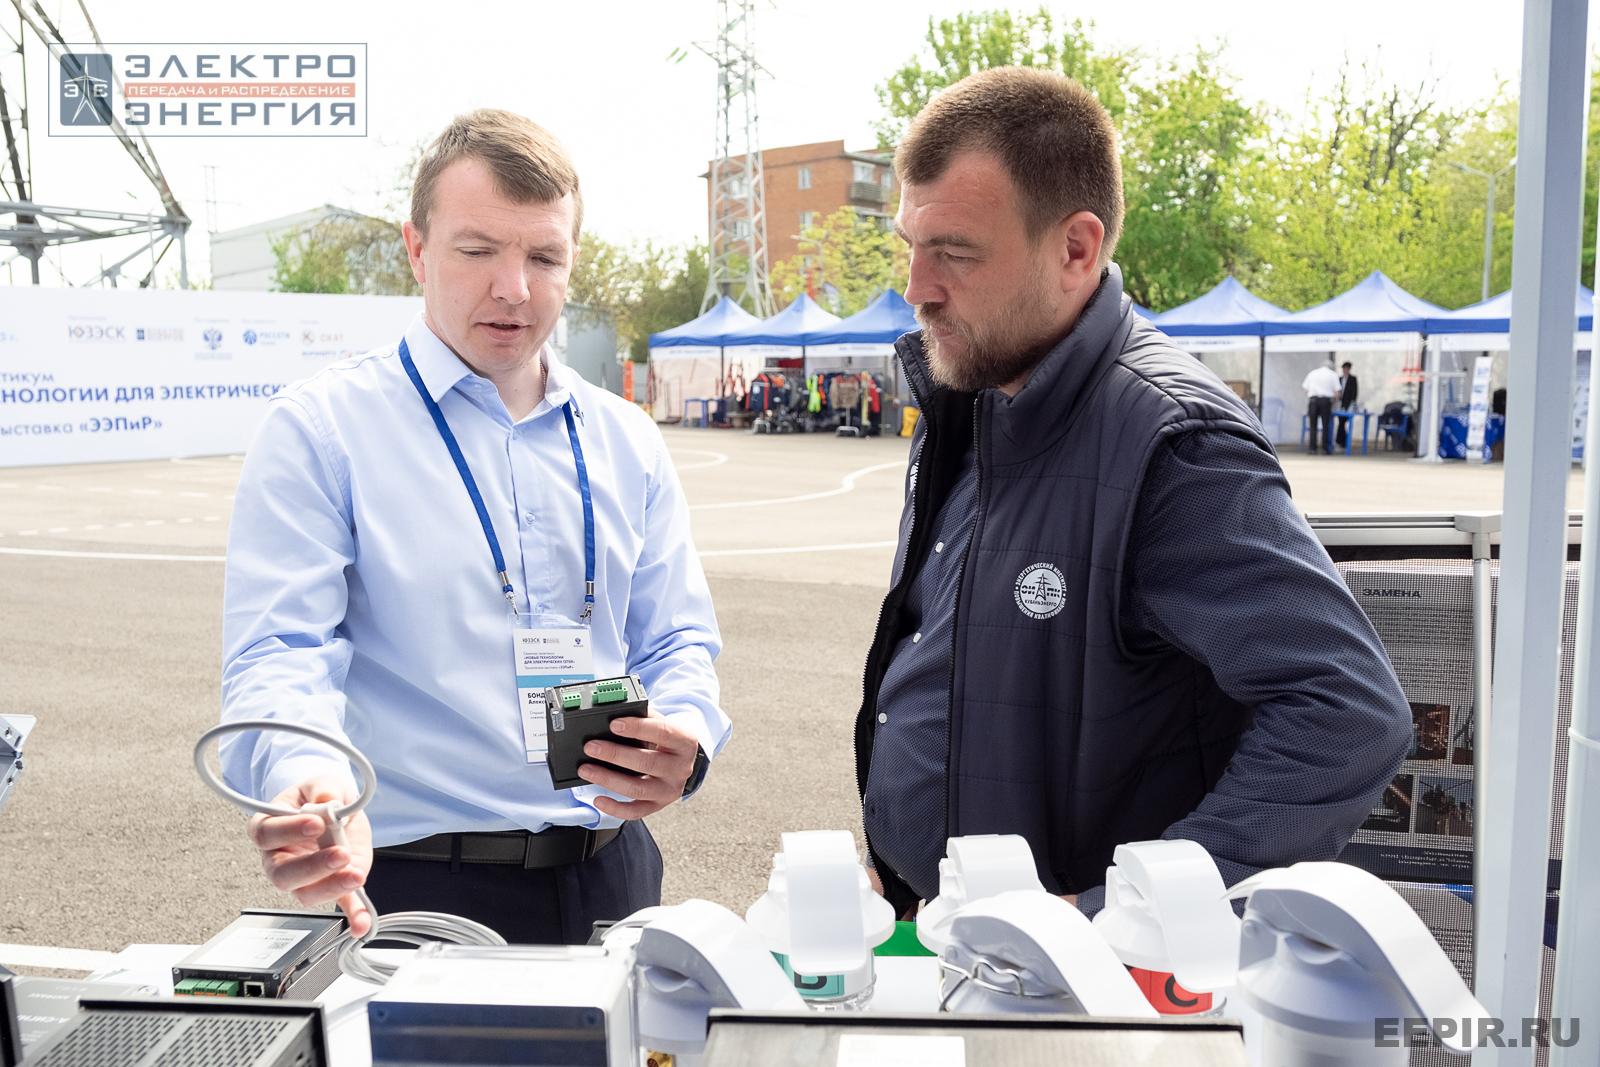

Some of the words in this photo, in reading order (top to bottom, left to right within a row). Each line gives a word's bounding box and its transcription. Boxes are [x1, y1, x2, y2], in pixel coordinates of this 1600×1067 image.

[68, 325, 125, 340] ЮЗЭСК
[0, 387, 109, 403] НОЛОГИИ
[114, 386, 155, 404] ДЛЯ
[160, 384, 287, 400] ЭЛЕКТРИЧЕСК
[1363, 588, 1421, 598] ЗАМЕНА
